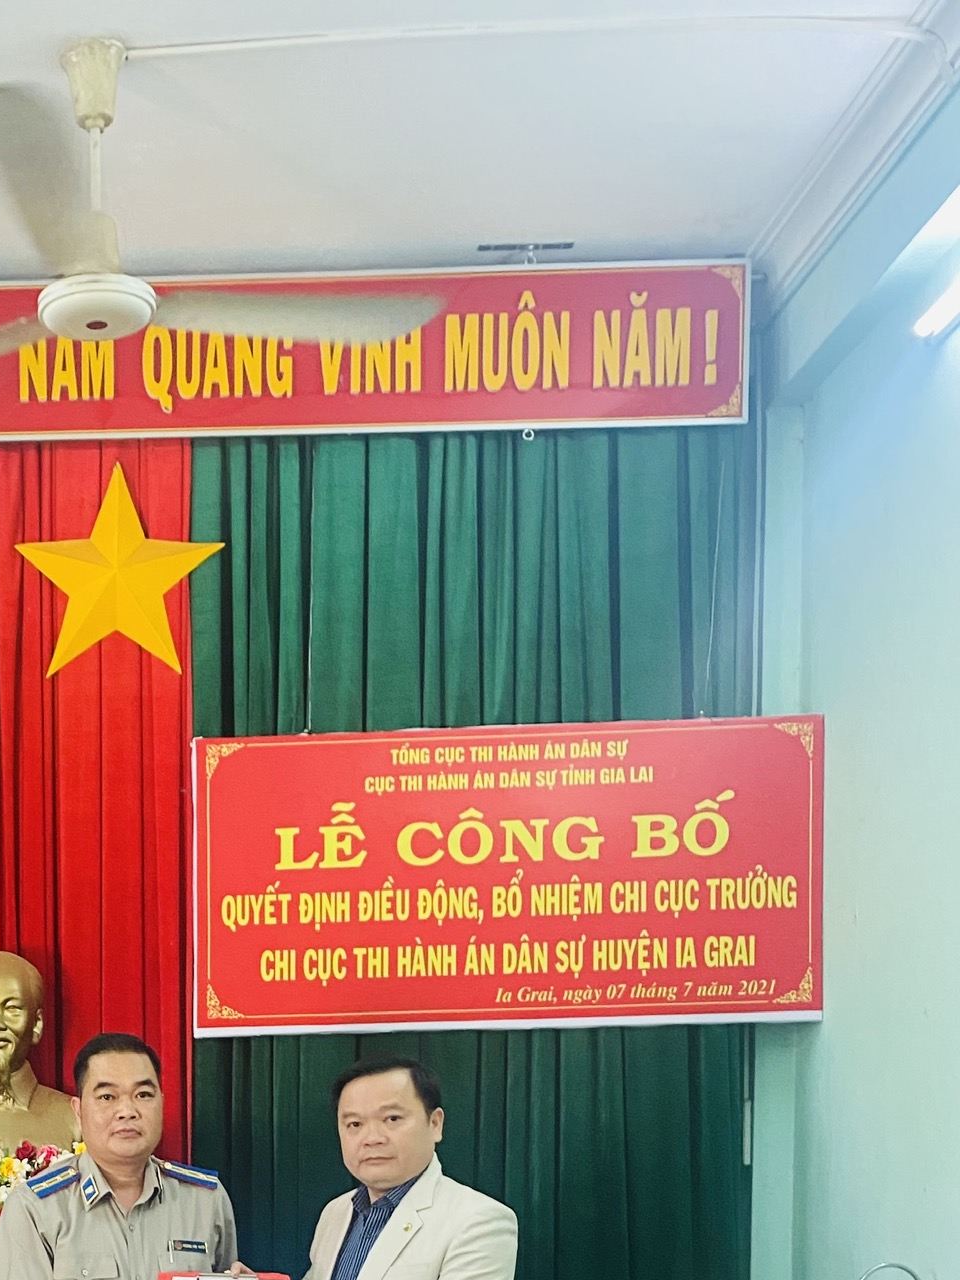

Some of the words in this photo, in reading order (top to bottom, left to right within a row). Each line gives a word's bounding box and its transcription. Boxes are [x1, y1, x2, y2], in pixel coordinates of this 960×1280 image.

[20, 335, 115, 403] NAM
[142, 324, 294, 414] QUANG
[319, 328, 422, 396] VINH
[444, 290, 571, 393] MUÔN
[593, 290, 691, 389] NĂM
[704, 308, 719, 386] !
[365, 776, 395, 795] CỤC
[400, 775, 422, 791] THI
[427, 772, 468, 790] HÀNH
[473, 771, 494, 789] ÁN
[499, 770, 531, 788] DÂN
[536, 768, 557, 789] SỰ
[561, 766, 595, 785] TỈNH
[600, 767, 625, 784] GIA
[630, 766, 653, 782] LAI
[391, 743, 430, 765] TỔNG
[434, 746, 465, 767] CỤC
[469, 745, 493, 763] THI
[498, 742, 539, 761] HÀNH
[544, 739, 565, 759] ÁN
[570, 739, 602, 758] DÂN
[607, 739, 628, 760] SỰ
[275, 802, 367, 870] LỄ
[396, 806, 604, 866] CÔNG
[631, 790, 735, 858] BỐ
[221, 881, 291, 932] QUYẾT
[299, 892, 350, 930] ĐỊNH
[358, 876, 409, 922] ĐIỀU
[417, 879, 483, 926] ĐỘNG,
[492, 868, 523, 918] BỔ
[531, 875, 602, 921] NHIỆM
[610, 880, 646, 914] CHI
[654, 879, 699, 918] CỤC
[706, 864, 797, 910] TRƯỞNG
[260, 950, 295, 981] CHI
[303, 948, 347, 986] CỤC
[353, 946, 389, 978] THI
[397, 937, 456, 977] HÀNH
[464, 936, 494, 976] ÁN
[502, 934, 548, 974] DÂN
[555, 934, 586, 978] SỰ
[593, 929, 667, 976] HUYỆN
[675, 936, 697, 968] IA
[704, 935, 755, 967] GRAI
[495, 987, 512, 1002] Ia
[517, 985, 557, 1003] Grai,
[563, 987, 602, 1004] ngày
[606, 983, 625, 999] 07
[631, 981, 677, 1001] tháng
[684, 981, 692, 995] 7
[697, 982, 733, 996] năm
[738, 979, 776, 995] 2021
